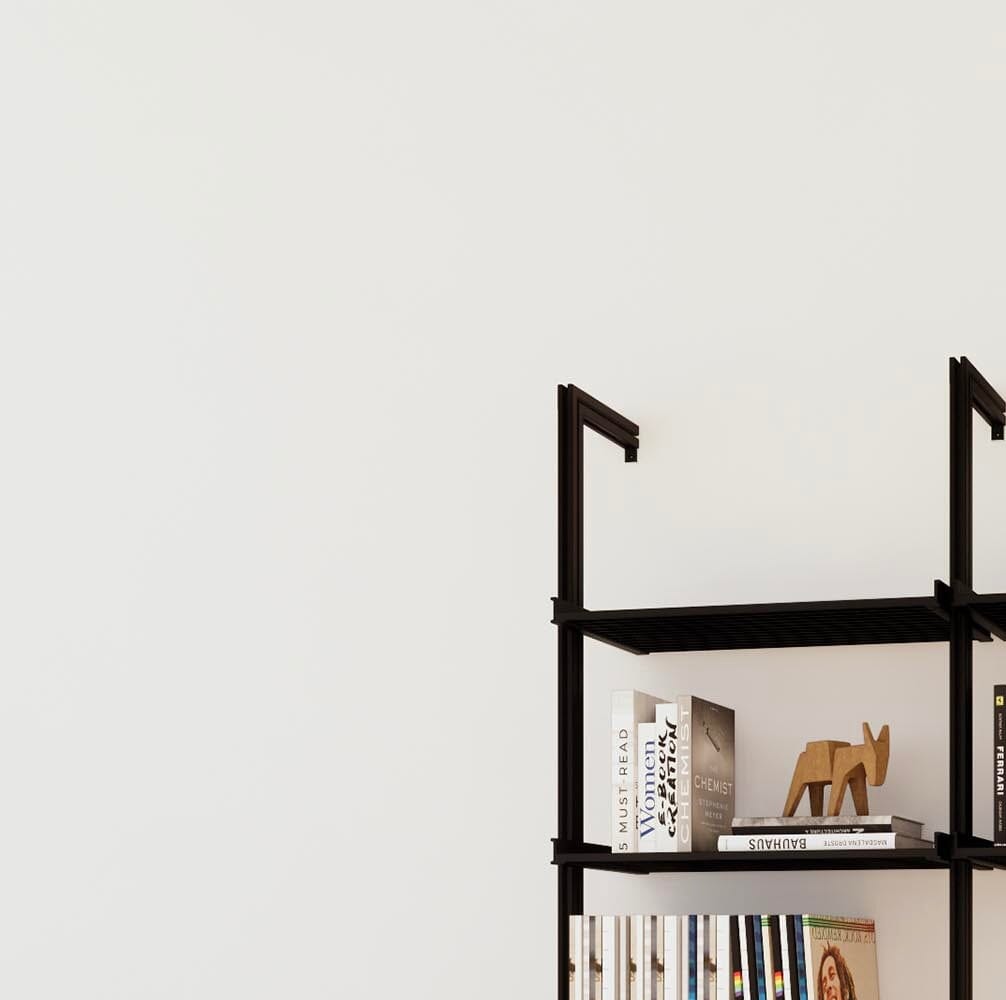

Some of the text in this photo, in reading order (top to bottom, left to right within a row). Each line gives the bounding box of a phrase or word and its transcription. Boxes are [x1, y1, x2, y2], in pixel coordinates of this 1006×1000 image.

[640, 741, 655, 838] Women
[658, 729, 668, 825] E-BOOK
[666, 716, 678, 838] CREATION
[681, 710, 689, 844] CHEMIST
[694, 775, 733, 796] CHEMIST
[749, 838, 807, 850] BAUHAUS
